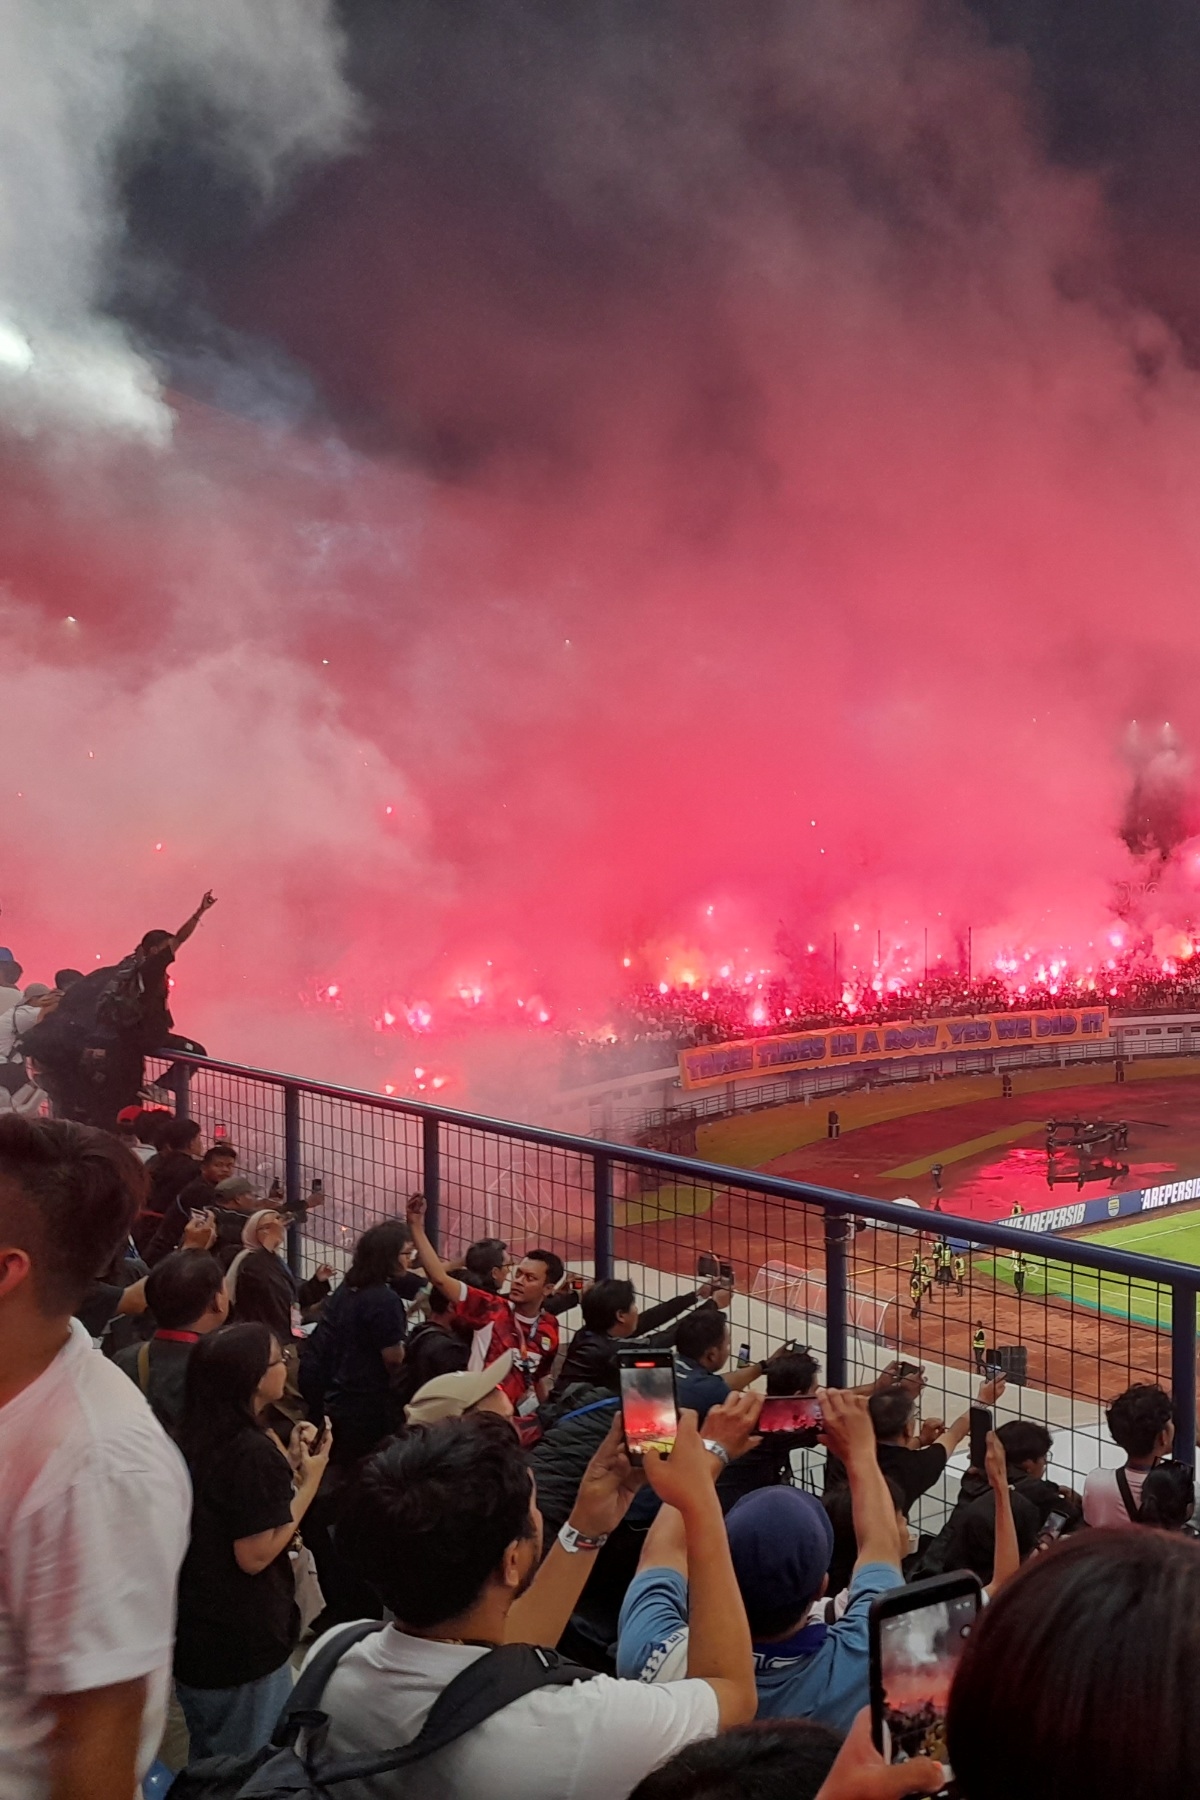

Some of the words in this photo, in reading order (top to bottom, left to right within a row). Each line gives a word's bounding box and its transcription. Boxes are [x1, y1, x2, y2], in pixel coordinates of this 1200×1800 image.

[686, 1046, 754, 1081] THREE
[756, 1036, 827, 1068] TIMES
[830, 1033, 858, 1057] IN
[860, 1031, 881, 1054] A
[884, 1025, 939, 1051] ROW
[947, 1021, 991, 1044] YES
[994, 1017, 1032, 1040] WE
[1036, 1014, 1078, 1037] DID
[1081, 1012, 1105, 1033] IT
[998, 1203, 1086, 1233] EAREPERSIB
